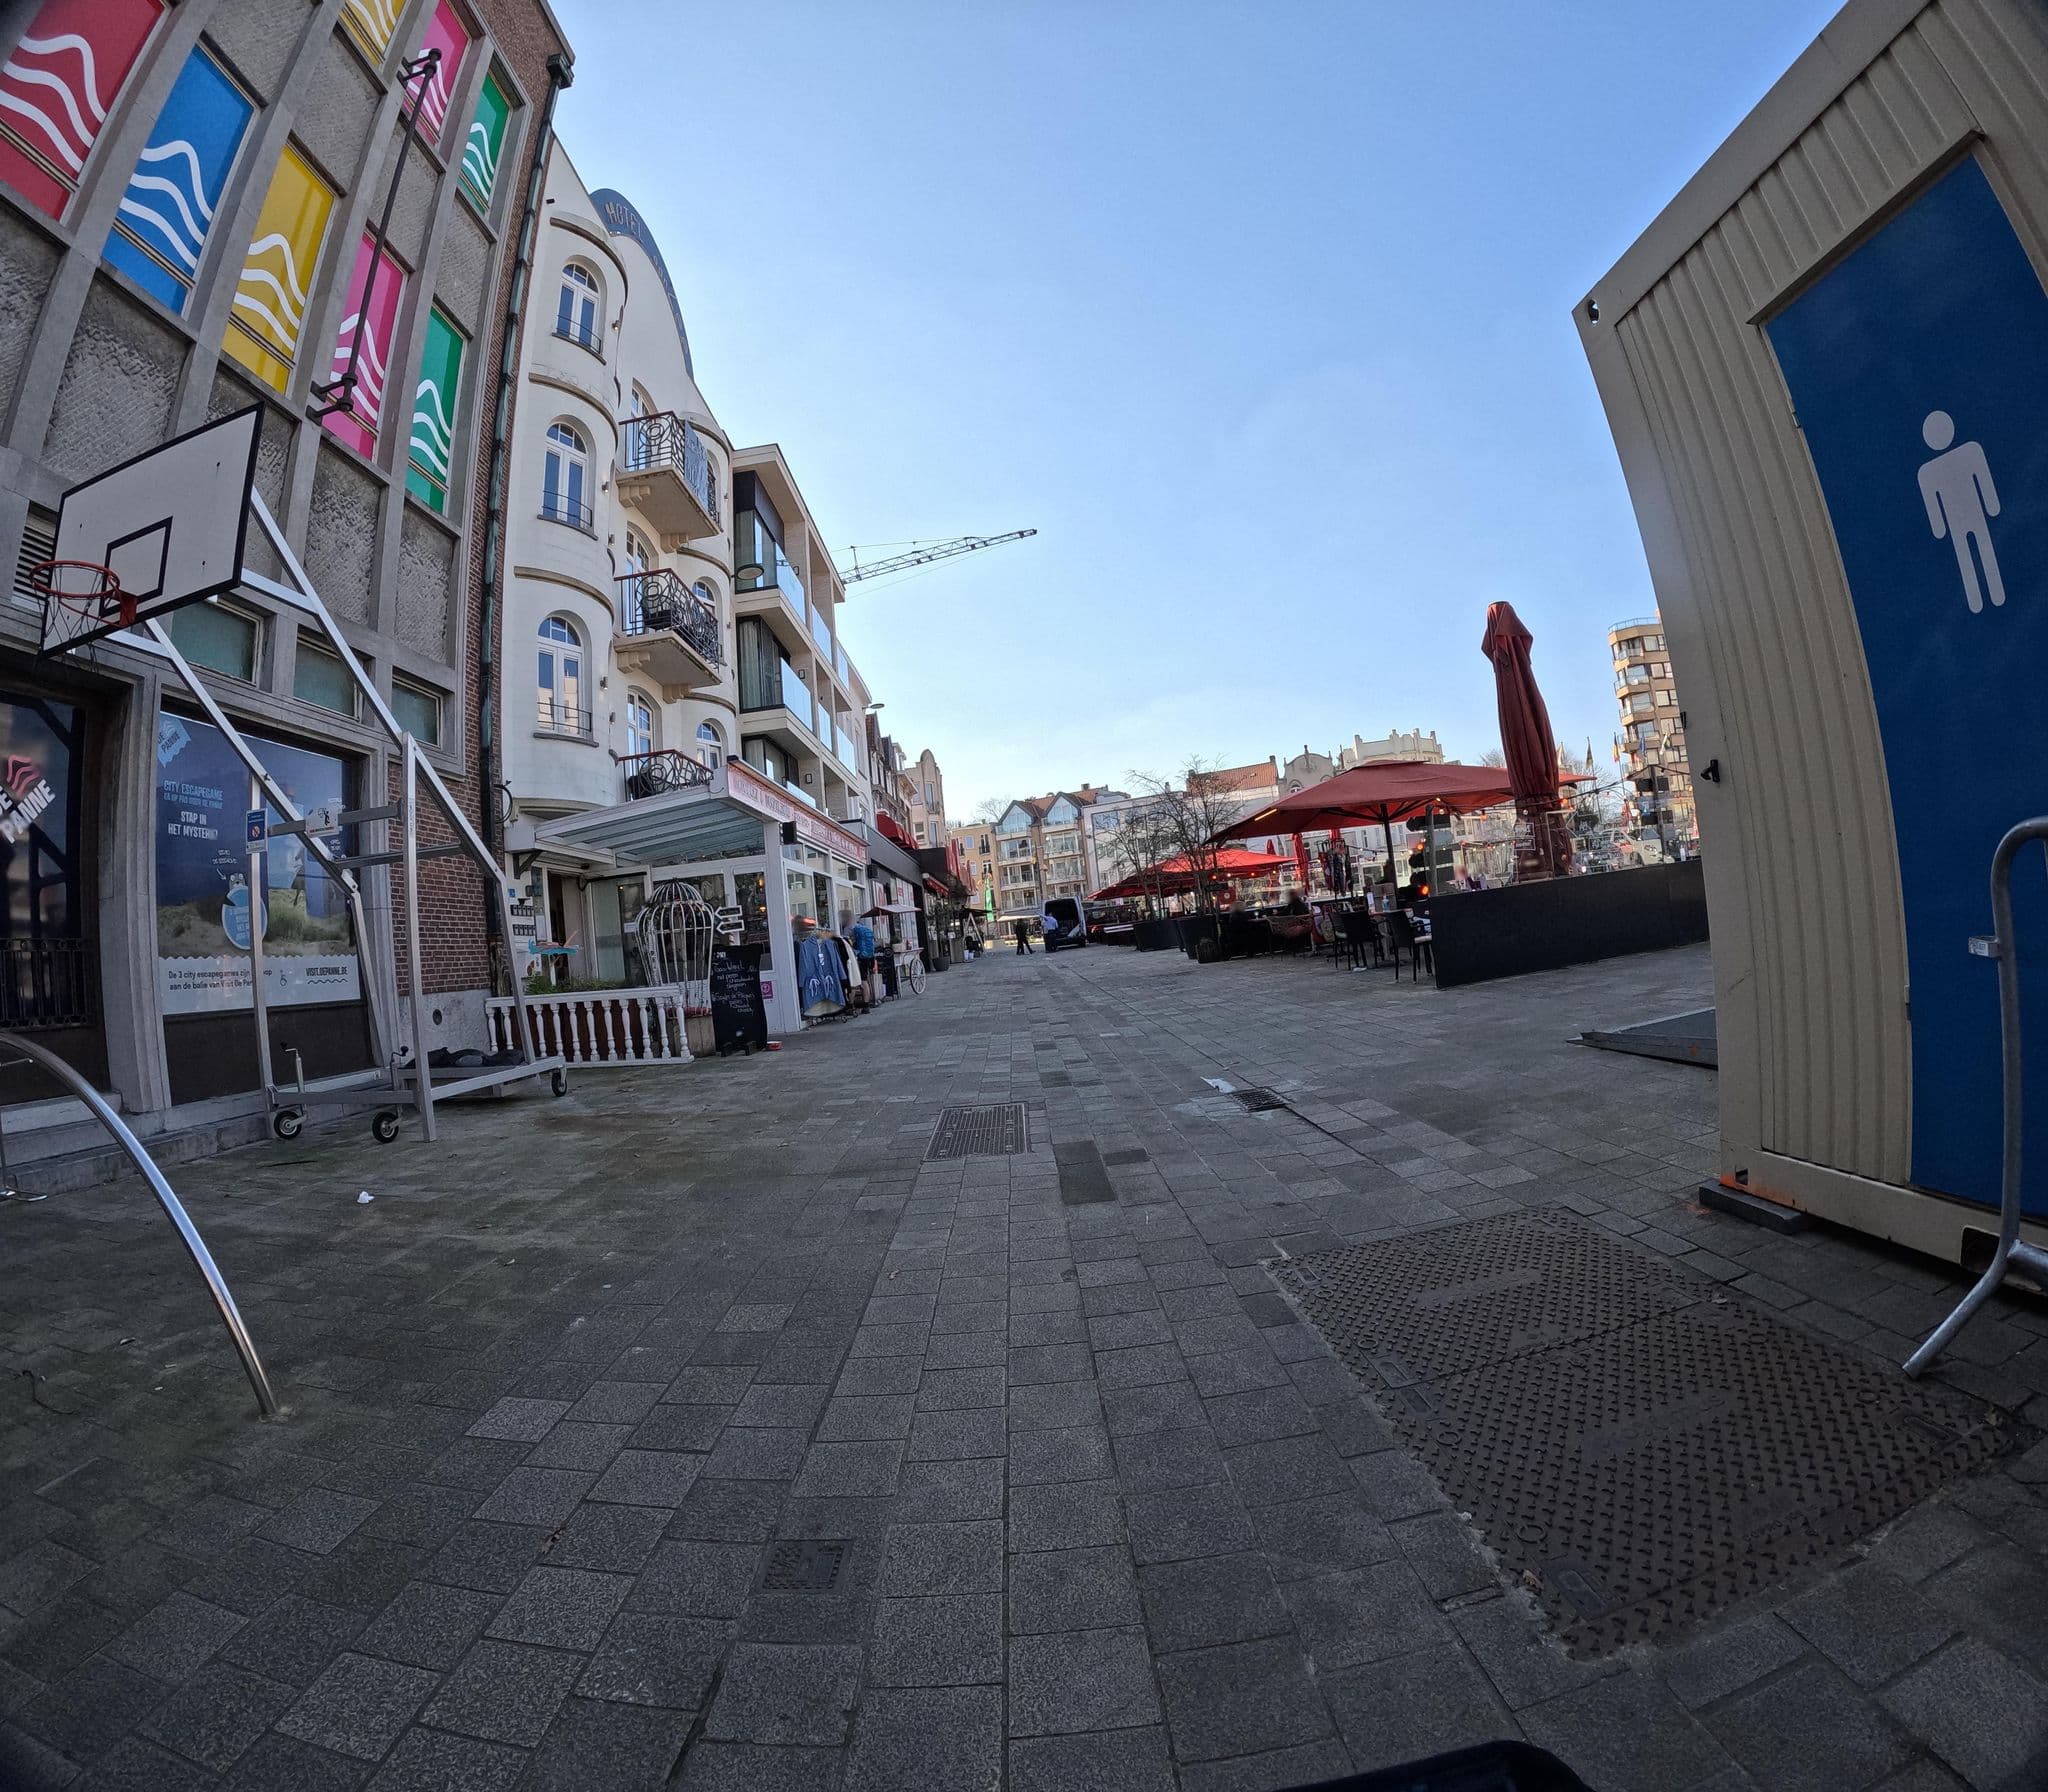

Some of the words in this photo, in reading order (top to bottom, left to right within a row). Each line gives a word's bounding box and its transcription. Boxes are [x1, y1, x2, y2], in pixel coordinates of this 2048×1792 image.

[605, 201, 643, 243] HOTEL
[164, 781, 180, 793] CITY
[182, 784, 224, 800] ESCAPEGAME
[0, 779, 56, 844] PANNE
[181, 812, 198, 824] STAP
[200, 814, 207, 825] IN
[168, 824, 181, 836] HET
[168, 970, 178, 979] De
[178, 970, 183, 979] 3
[183, 970, 196, 981] city
[197, 970, 239, 980] escapegames
[305, 966, 348, 977] VISIT.DEPANNE.BE
[169, 982, 182, 991] aan
[182, 981, 191, 991] de
[192, 980, 208, 990] balie
